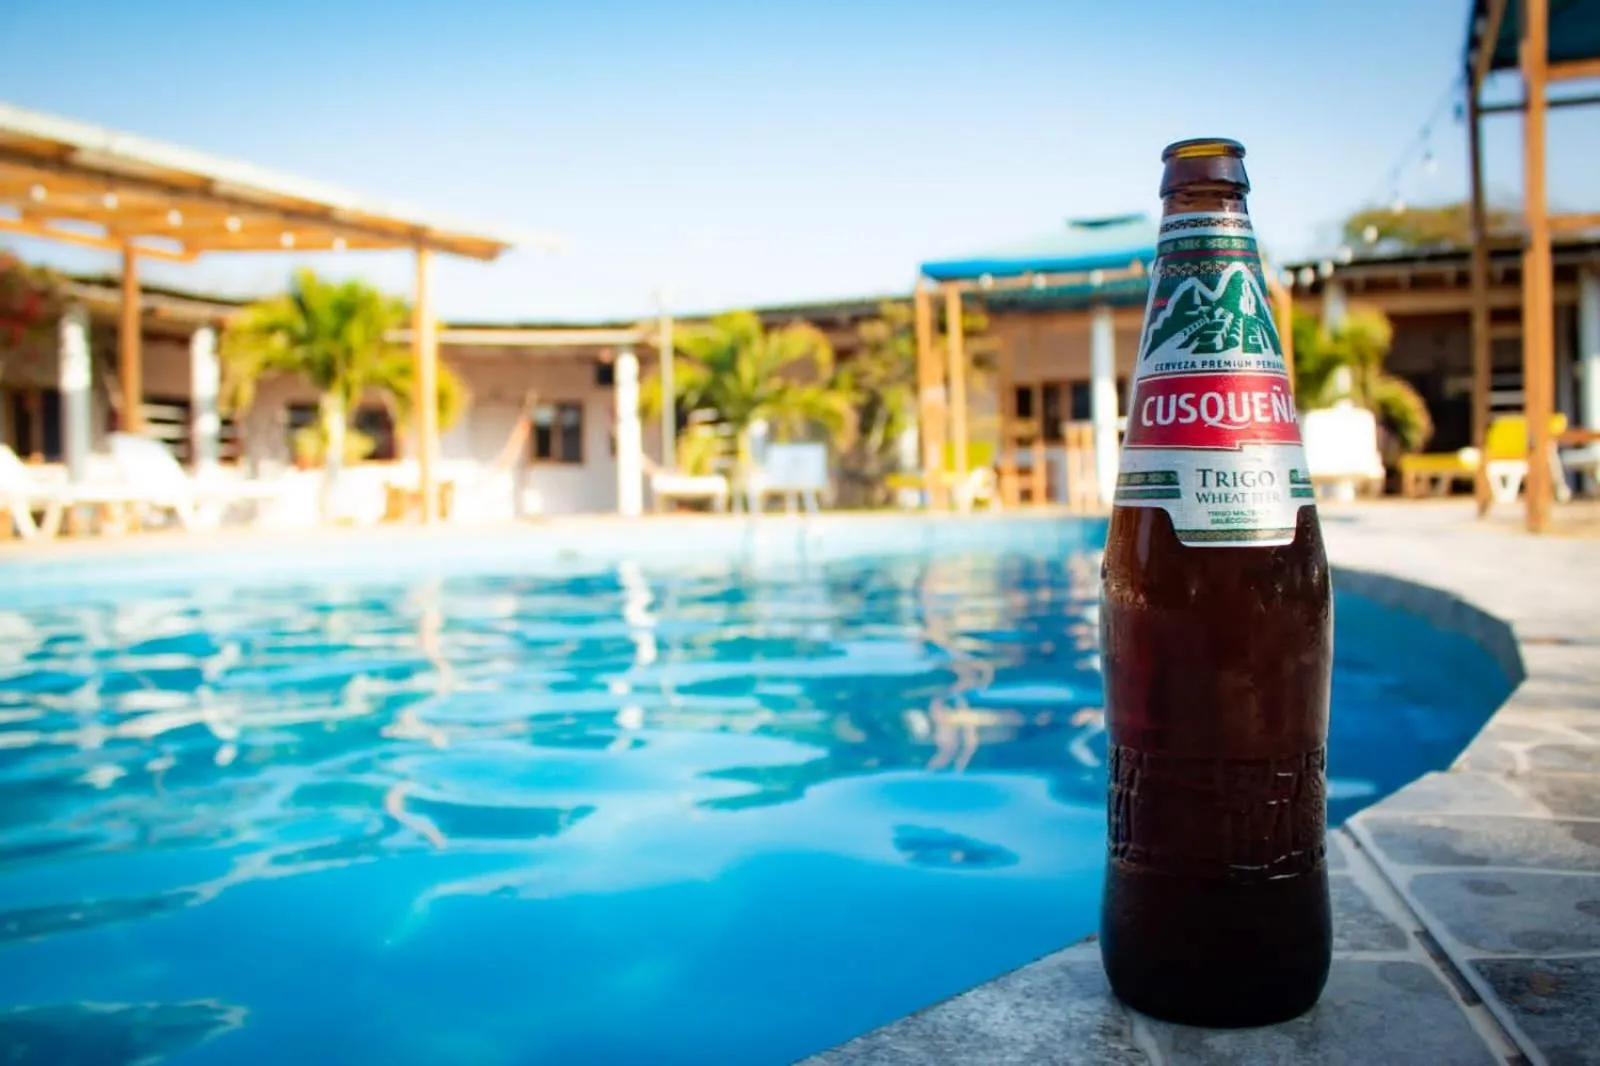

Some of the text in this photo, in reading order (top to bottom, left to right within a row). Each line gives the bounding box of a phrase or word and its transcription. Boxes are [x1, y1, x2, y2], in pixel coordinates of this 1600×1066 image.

[1154, 361, 1197, 372] CERVEZA
[1201, 360, 1252, 368] PREMIUM
[1142, 386, 1299, 430] CUSQUEÑA
[1196, 468, 1276, 488] TRIGO
[1195, 491, 1249, 504] WHEAT
